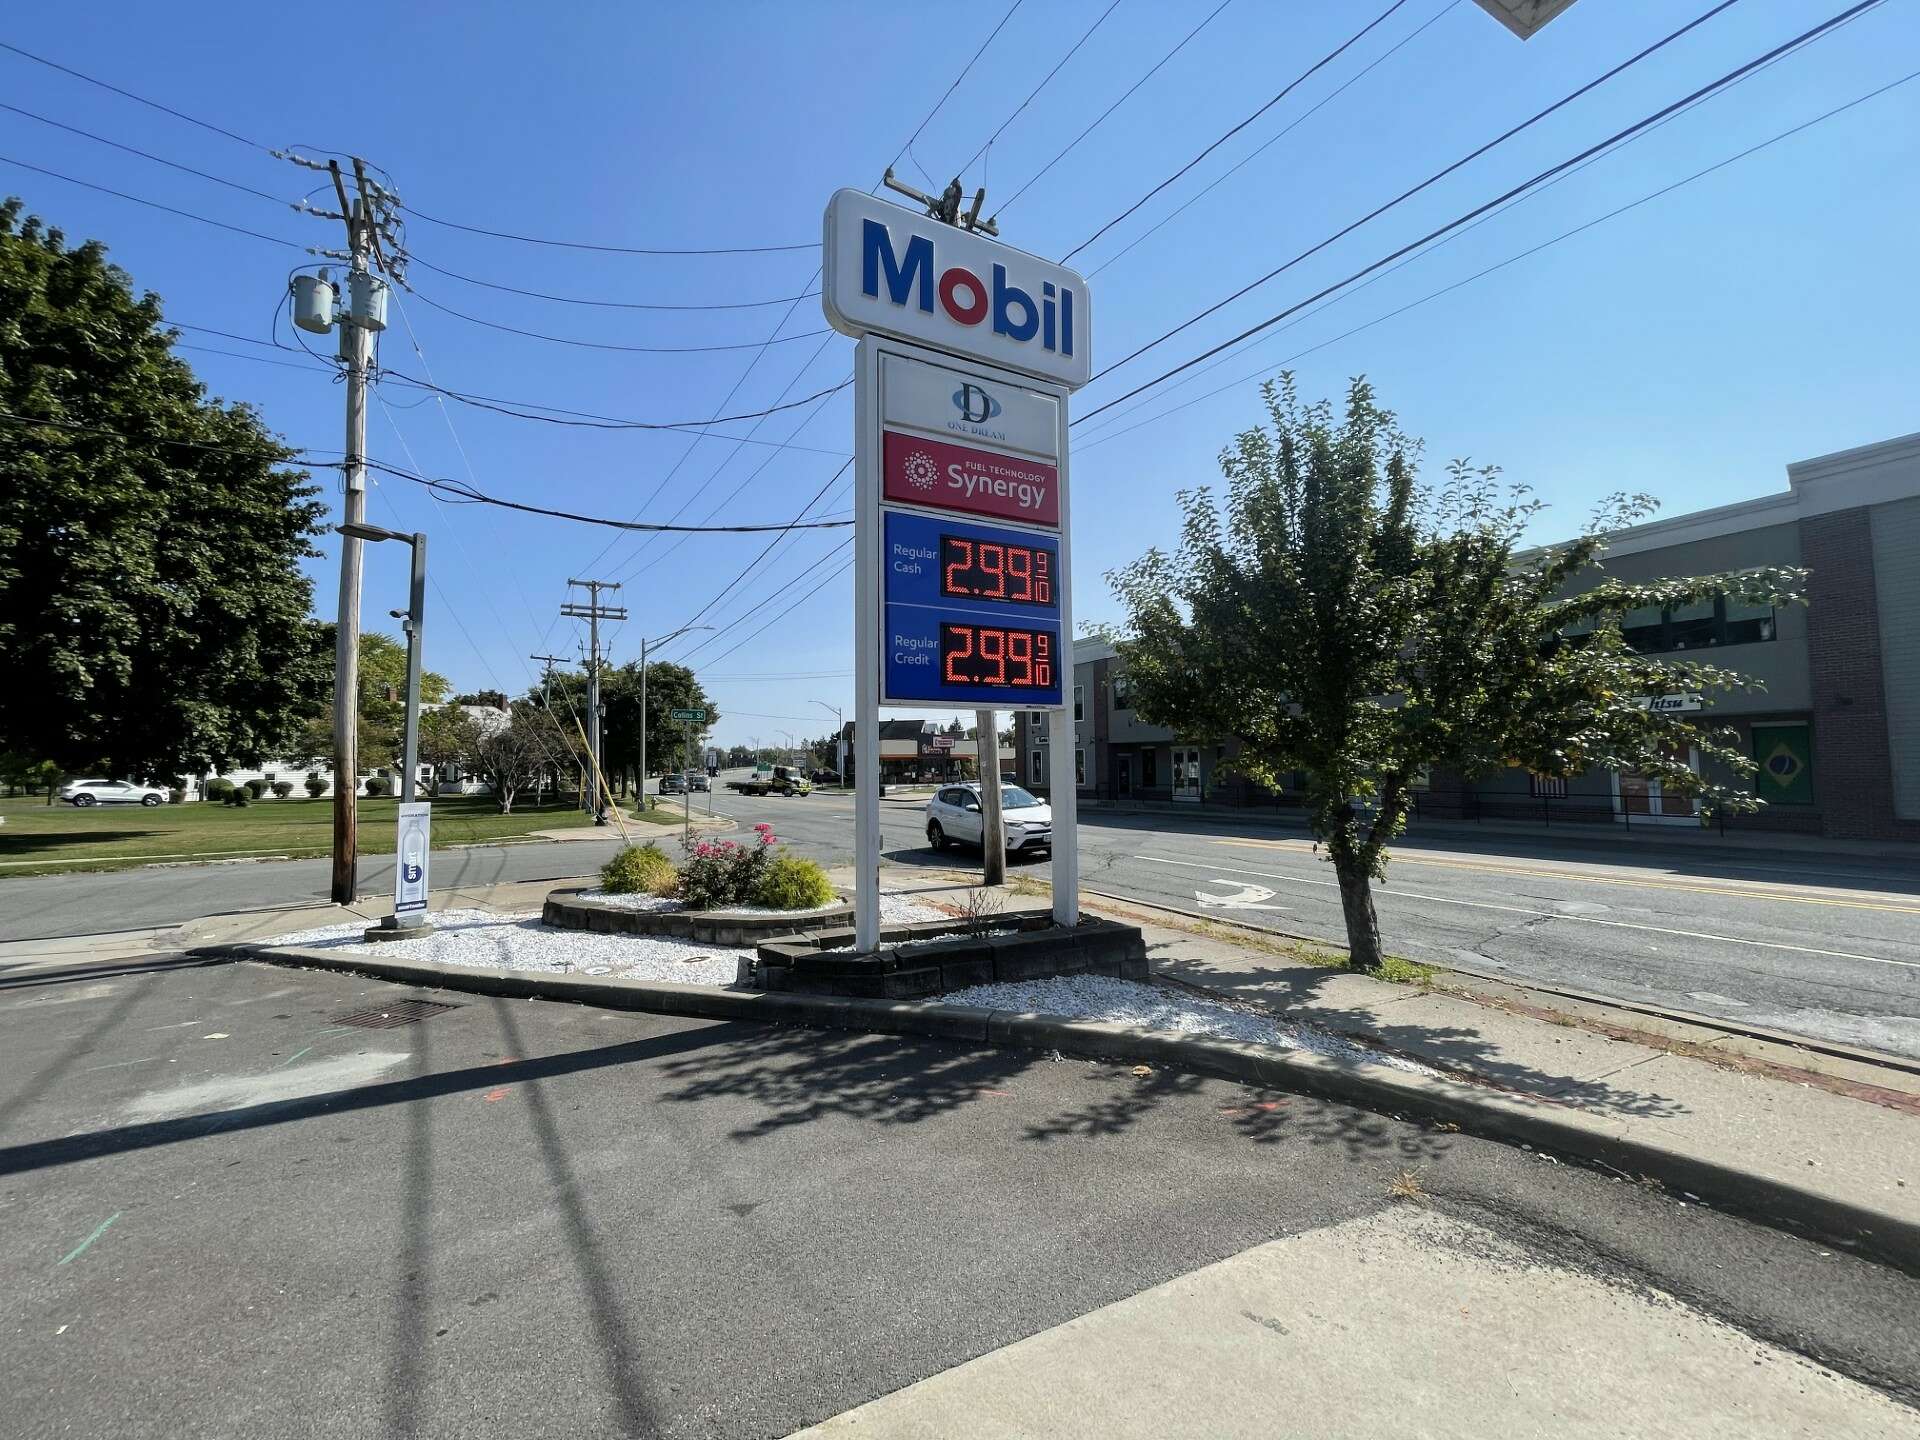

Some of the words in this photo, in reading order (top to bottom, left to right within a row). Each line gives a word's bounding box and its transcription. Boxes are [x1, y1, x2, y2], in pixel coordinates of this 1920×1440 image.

[862, 218, 1073, 359] Mobil
[948, 421, 968, 433] ONE
[971, 426, 1006, 441] DREAM
[965, 461, 986, 472] FUEL
[989, 465, 1046, 483] TECHNOLOGY
[947, 464, 1046, 510] Synergy
[893, 543, 938, 560] Regular
[893, 561, 922, 575] Cash
[895, 635, 938, 650] Regular
[895, 652, 930, 666] Credit
[673, 711, 693, 719] Collins
[696, 711, 704, 719] St
[407, 851, 417, 880] smart
